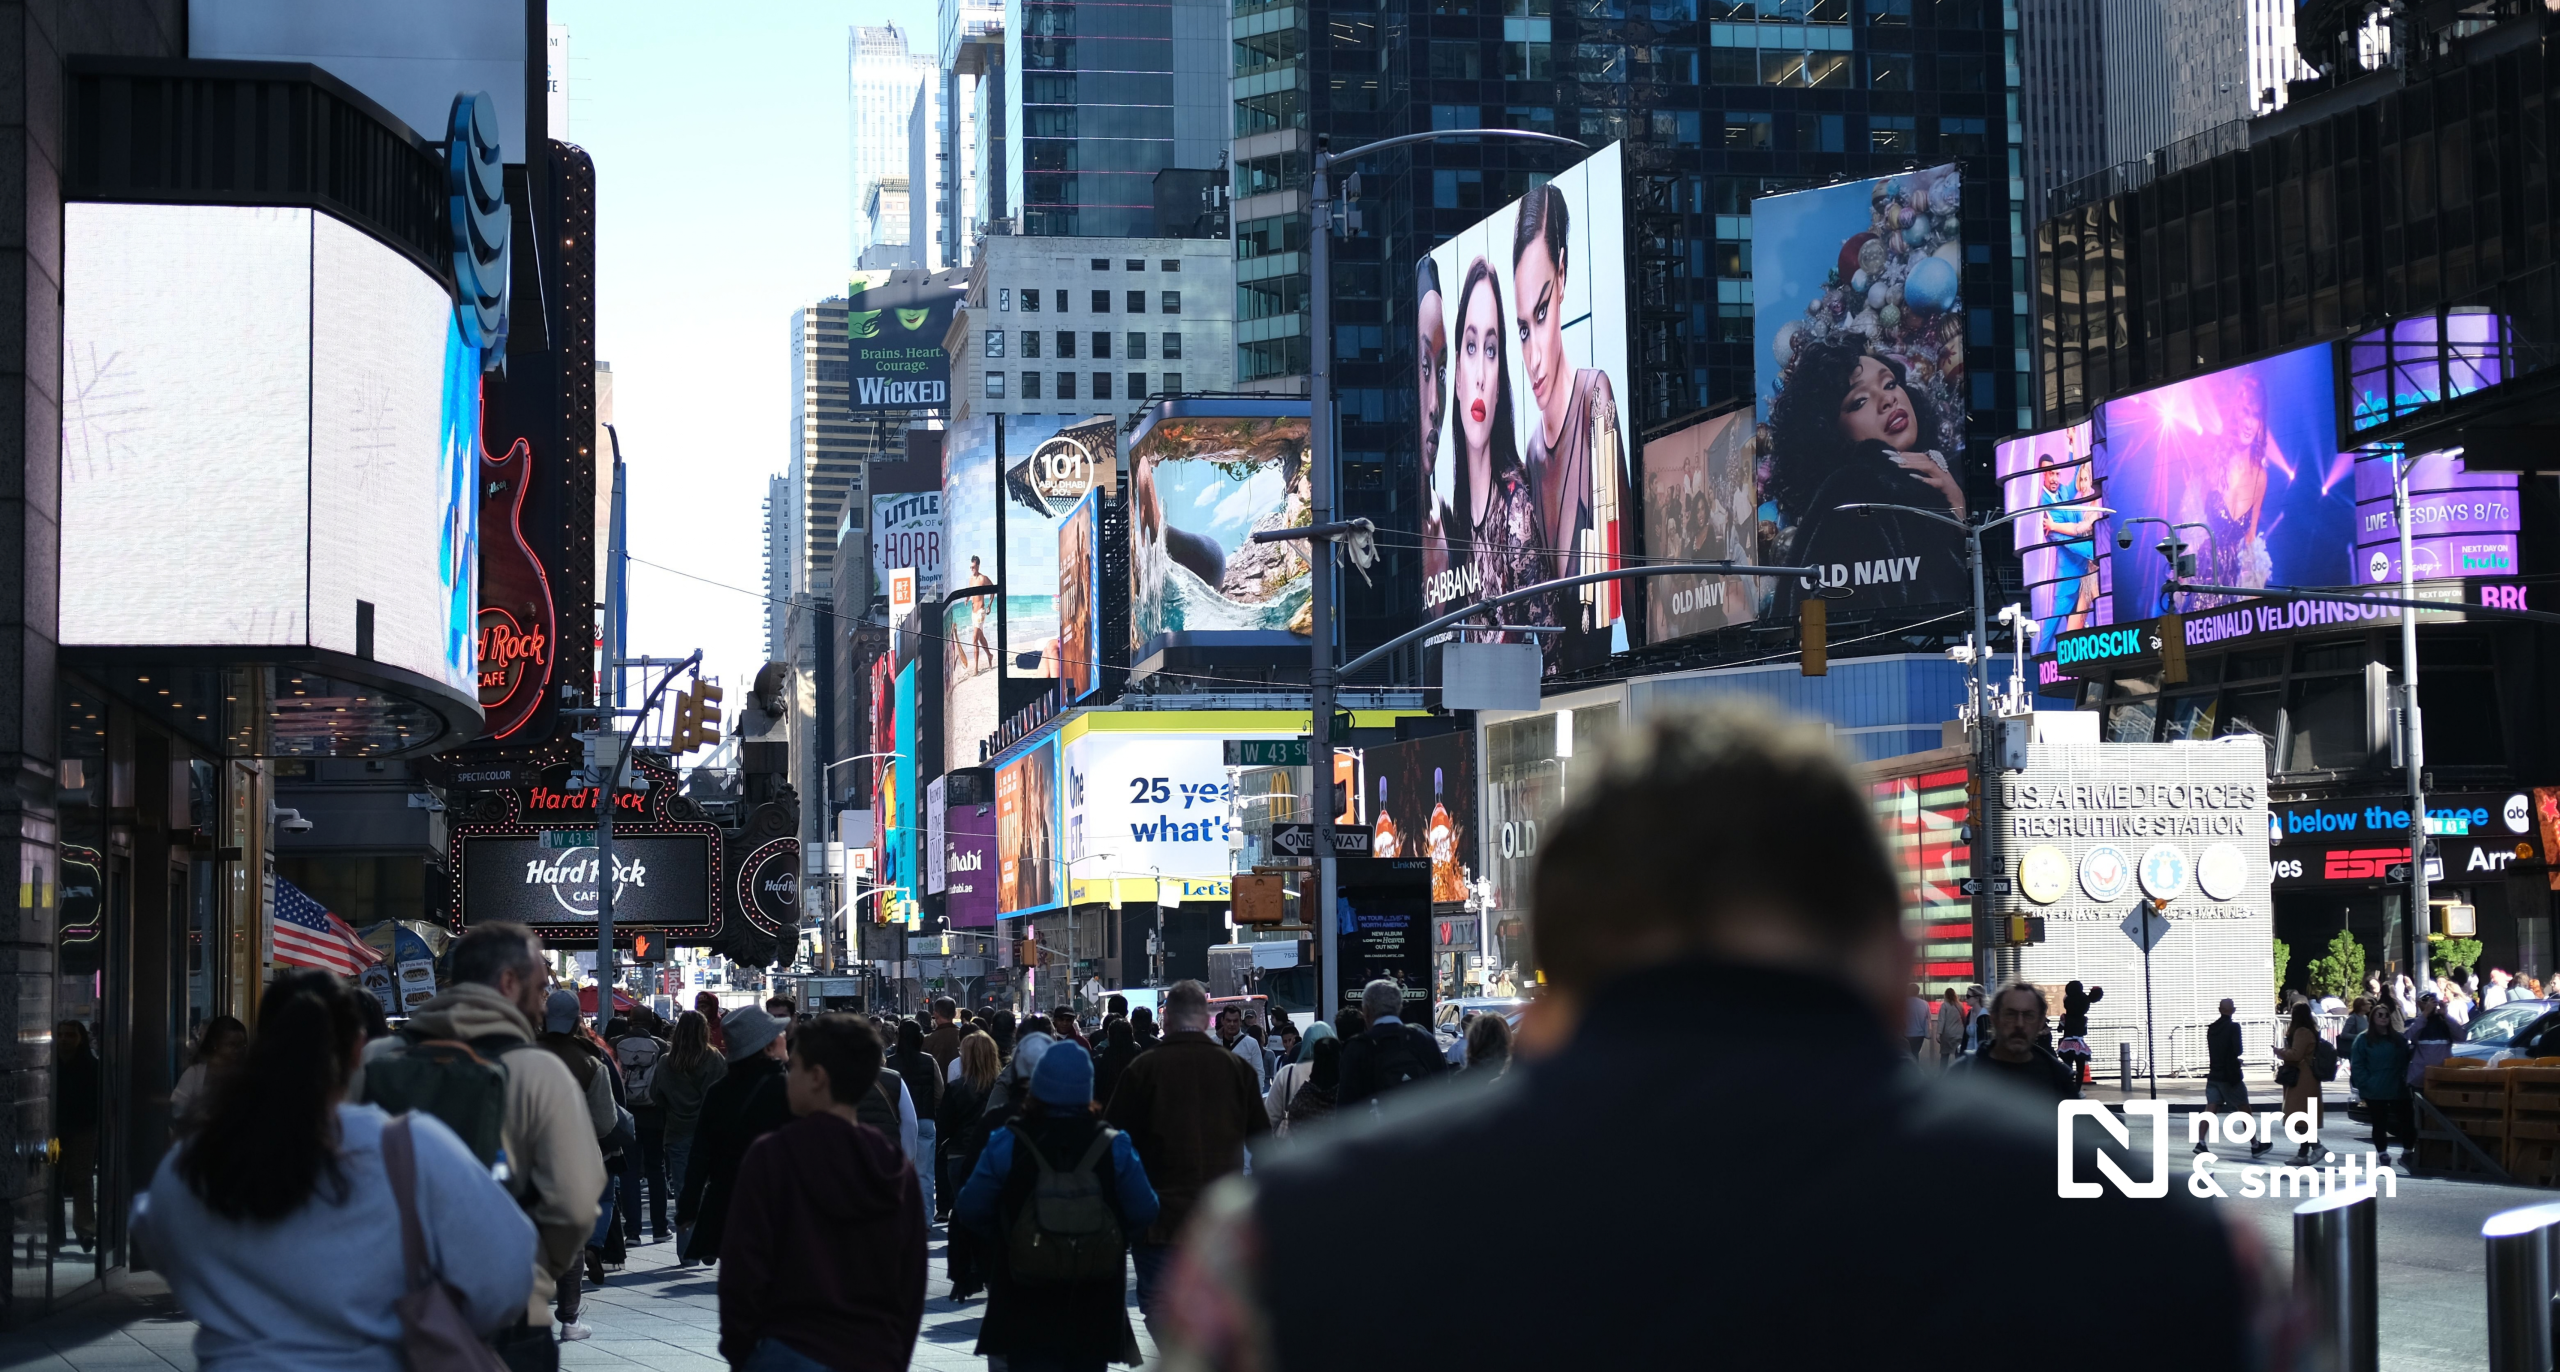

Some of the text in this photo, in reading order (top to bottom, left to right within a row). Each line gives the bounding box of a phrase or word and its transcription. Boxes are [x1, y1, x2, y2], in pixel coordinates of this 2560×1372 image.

[860, 347, 944, 360] Brains. Heart.
[875, 360, 929, 374] Courage.
[1040, 453, 1082, 479] 101
[1039, 480, 1086, 489] ABU DHABI
[884, 495, 939, 530] LITTLE
[2365, 502, 2510, 532] LIVE TESDAYS 8/7c
[924, 519, 937, 527] OF
[2462, 544, 2509, 553] NEXT DAY ON
[1854, 556, 1921, 586] NAVY
[2371, 560, 2388, 572] abc
[2463, 553, 2510, 570] hulu
[1426, 560, 1482, 608] GABBANA
[1672, 581, 1727, 616] OLD NAVY
[2419, 590, 2462, 599] NEXT DAY ON
[2185, 608, 2252, 646] REGINALD
[491, 623, 545, 668] Rock
[1245, 744, 1260, 762] W
[1267, 743, 1287, 762] 43
[457, 770, 511, 782] SPECTACOLOR
[1069, 765, 1084, 810] One
[1129, 777, 1171, 804] 25
[2001, 781, 2258, 811] U.S. ARMED FORCES
[530, 787, 588, 810] Hard
[2288, 808, 2357, 834] below
[2364, 805, 2410, 830] the
[2507, 806, 2529, 819] ab
[2013, 815, 2152, 839] RECRUITING
[2154, 814, 2246, 838] STATION
[2446, 820, 2457, 833] 43
[553, 833, 564, 845] W
[569, 832, 582, 846] 43
[1070, 813, 1086, 860] ETF.
[1285, 834, 1313, 847] ONE
[1501, 819, 1538, 859] OLD
[526, 860, 588, 884] Hard
[1392, 861, 1427, 869] LinkNYC
[2325, 848, 2413, 880] ESP
[2394, 868, 2411, 879] ONE
[764, 879, 787, 892] Hard
[1183, 881, 1229, 896] Let's
[1968, 883, 1982, 891] ONE
[668, 971, 680, 994] tkts
[1347, 990, 1364, 999] CHA
